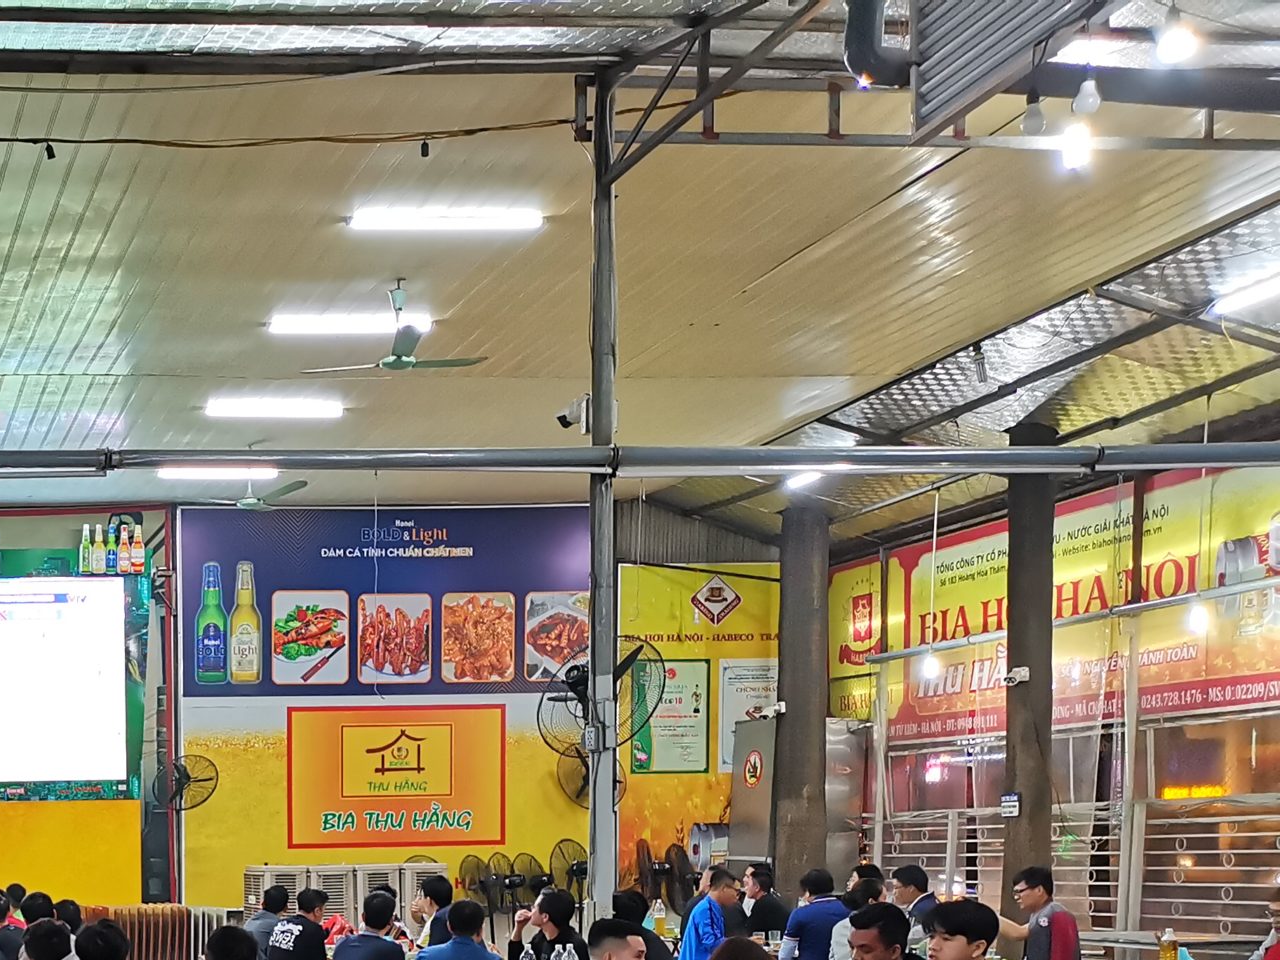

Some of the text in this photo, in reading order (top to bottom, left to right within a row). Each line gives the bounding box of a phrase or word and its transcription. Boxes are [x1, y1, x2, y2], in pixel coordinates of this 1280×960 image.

[361, 528, 448, 545] BOLD & Light
[976, 554, 985, 564] TY
[712, 632, 754, 642] HABECO
[232, 645, 258, 658] Light
[367, 781, 391, 792] THU
[321, 811, 357, 832] BIA
[364, 810, 406, 832] THU
